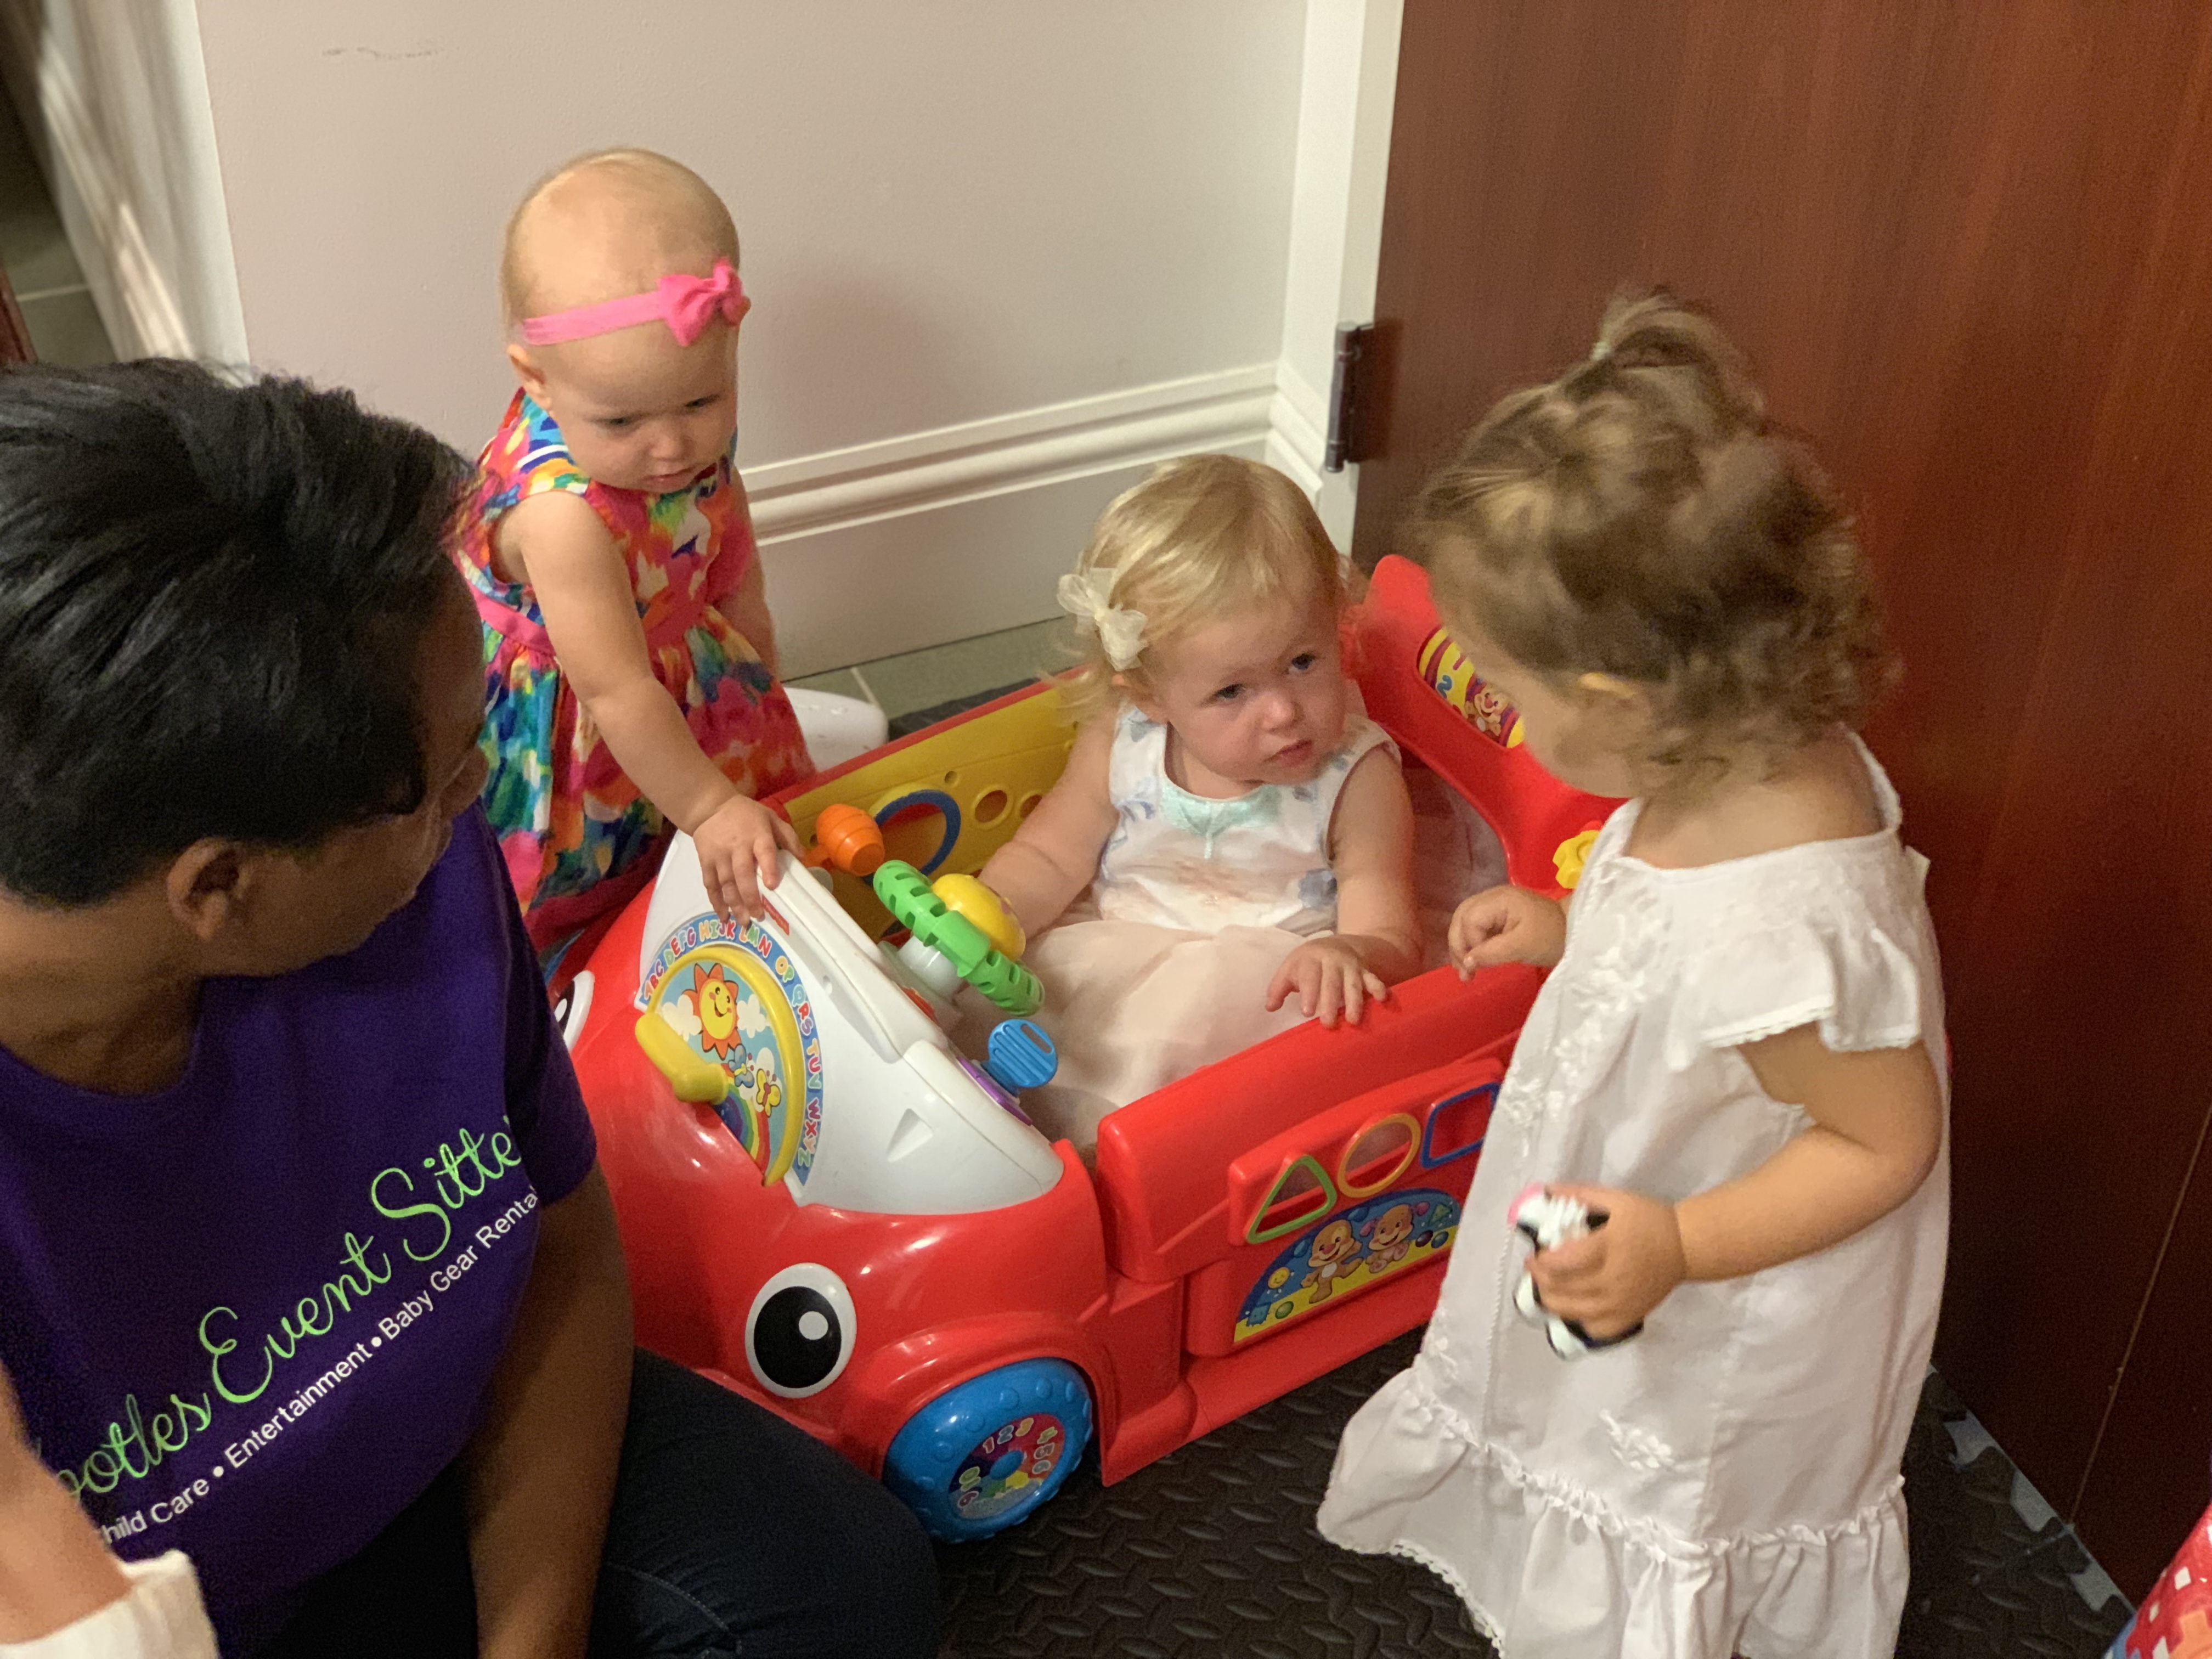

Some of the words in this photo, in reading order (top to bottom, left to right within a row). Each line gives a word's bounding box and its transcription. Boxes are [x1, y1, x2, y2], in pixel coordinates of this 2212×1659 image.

[663, 926, 696, 968] DEFG
[698, 918, 737, 942] HIJK
[775, 955, 795, 984] OP
[792, 984, 814, 1036] QRS
[806, 1037, 822, 1089] TUV
[798, 1097, 821, 1168] WXYZ
[200, 1232, 392, 1403] Event
[371, 1115, 522, 1261] Sitte
[100, 1510, 147, 1544] hild
[151, 1479, 210, 1523] Care
[224, 1342, 374, 1469] Entertainment
[378, 1290, 434, 1340] Baby
[430, 1245, 479, 1291] Gear
